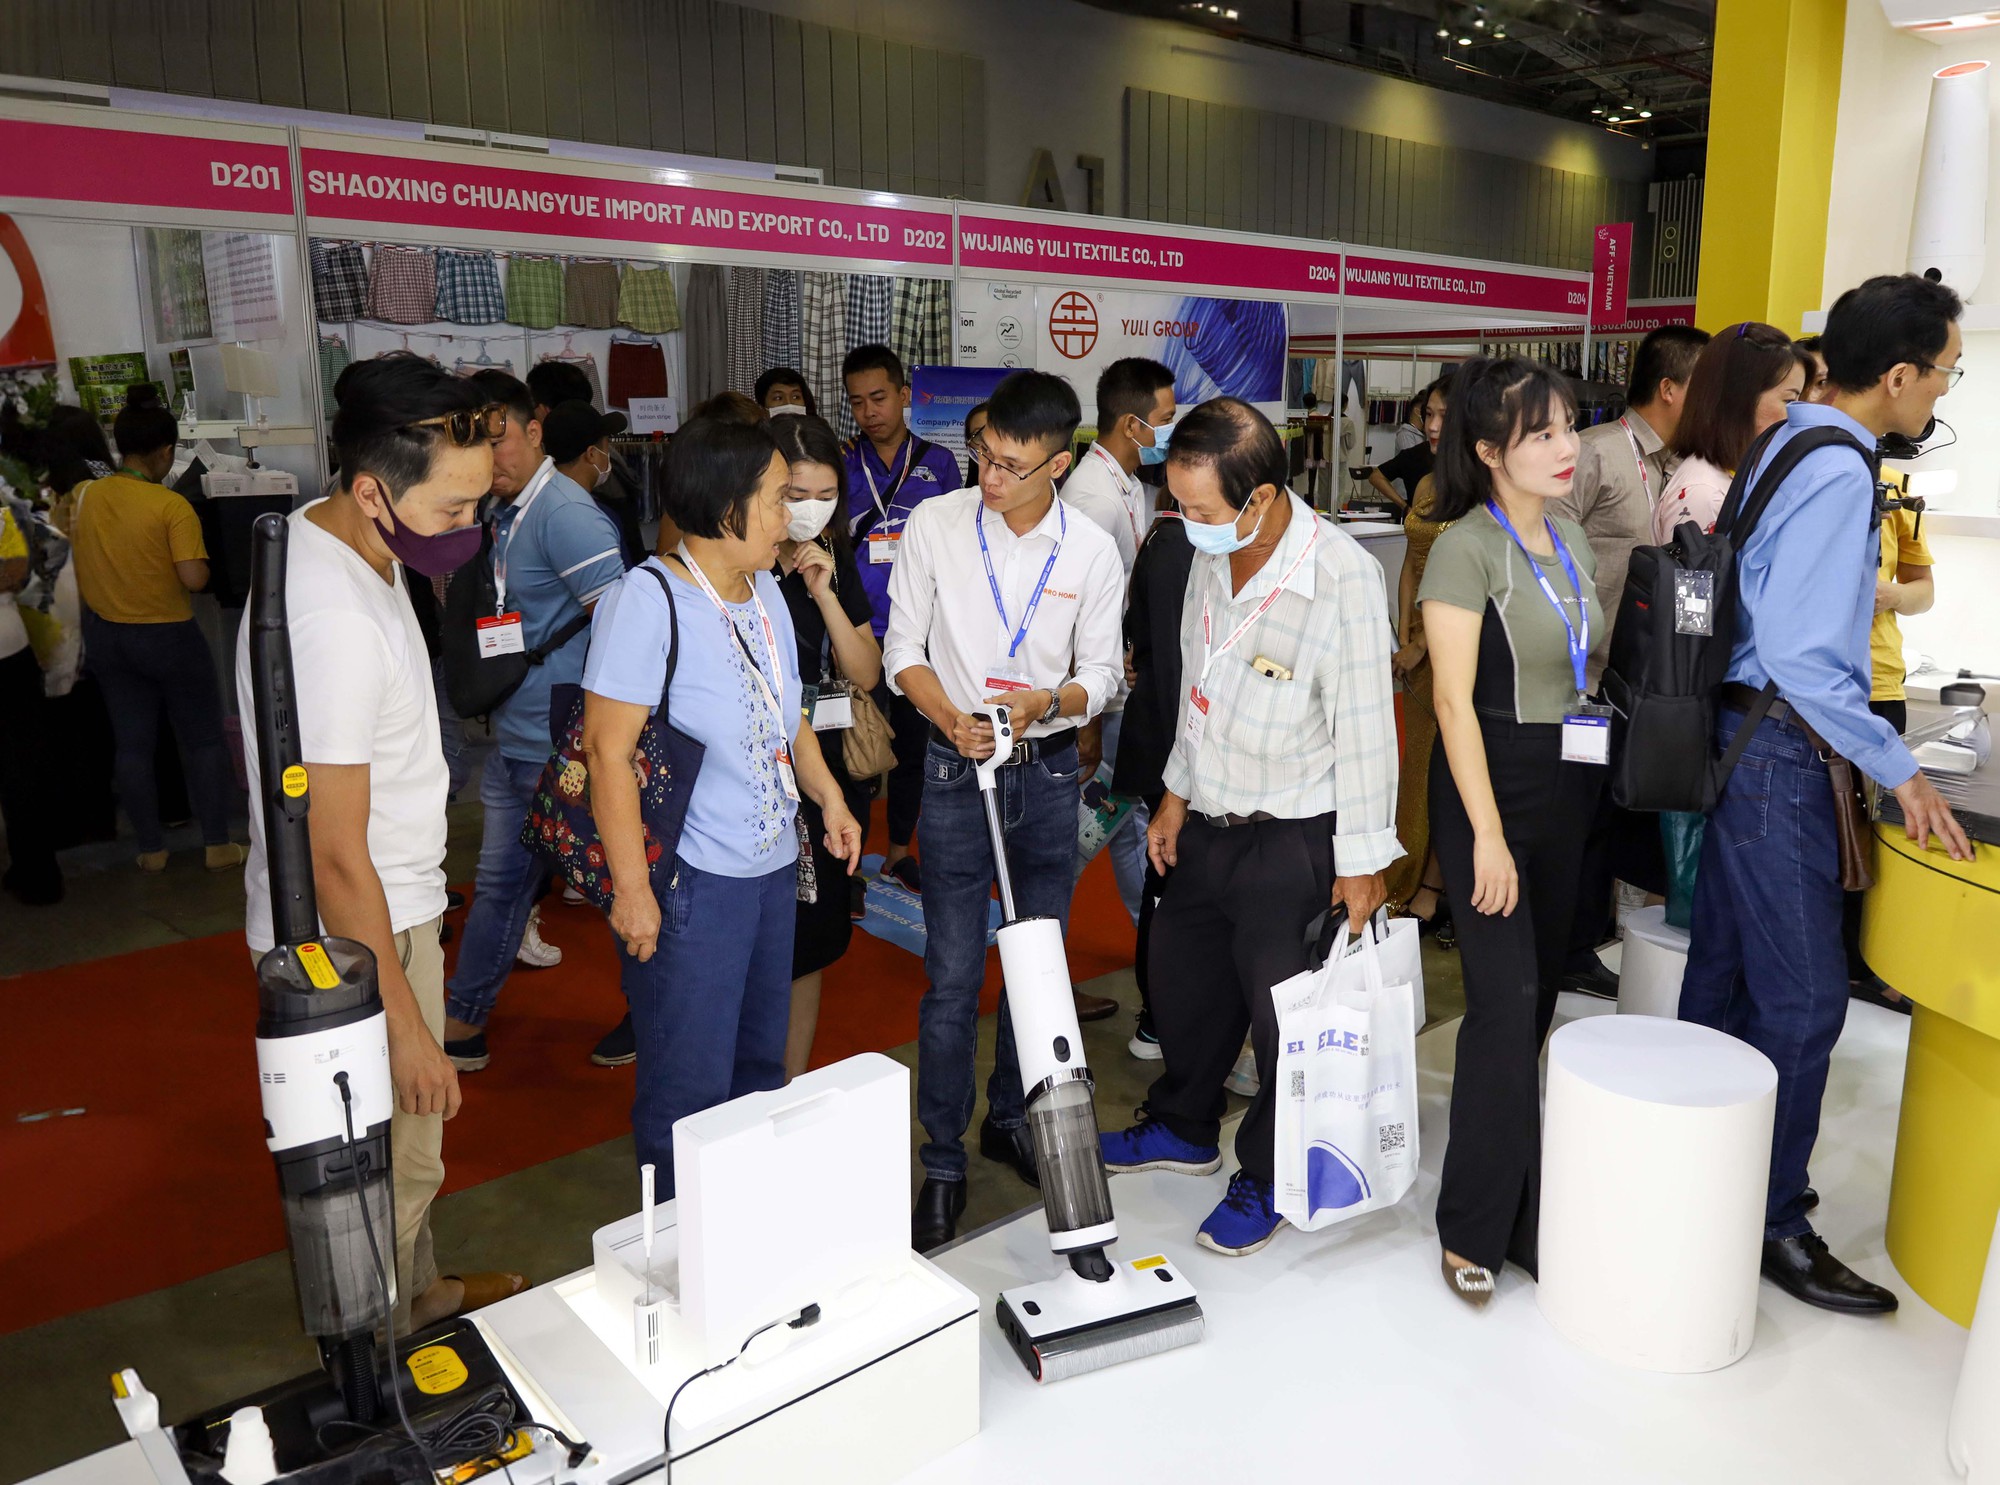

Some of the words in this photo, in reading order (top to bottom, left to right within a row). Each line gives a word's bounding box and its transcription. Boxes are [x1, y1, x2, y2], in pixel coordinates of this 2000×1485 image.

[211, 161, 281, 191] D201
[308, 170, 447, 204] SHAOXING
[453, 183, 600, 217] CHUANGYUE
[605, 197, 685, 225] IMPORT
[691, 206, 734, 229] AND
[738, 211, 814, 236] EXPORT
[819, 219, 852, 242] CO.,
[857, 222, 890, 243] LTD
[904, 228, 946, 250] D202
[962, 232, 1034, 255] WUJIANG
[1036, 238, 1070, 259] YULI
[1073, 242, 1129, 263] TEXTILE
[1132, 248, 1157, 267] CO.,
[1160, 250, 1184, 268] LTD
[1309, 265, 1336, 282] D204
[1608, 238, 1617, 258] AFF
[1345, 267, 1391, 286] WUJIANG
[1392, 272, 1413, 288] YULI
[1415, 274, 1451, 292] TEXTILE
[1452, 278, 1469, 295] CO.,
[1470, 281, 1486, 295] LTD
[1567, 291, 1586, 305] D204
[1605, 264, 1615, 311] VIETNAM
[1121, 319, 1148, 336] YULI
[1153, 320, 1199, 337] GROUP
[1557, 324, 1596, 332] TRADIG
[917, 418, 950, 427] Company
[1058, 591, 1077, 600] HOME
[1317, 1029, 1358, 1052] ELE
